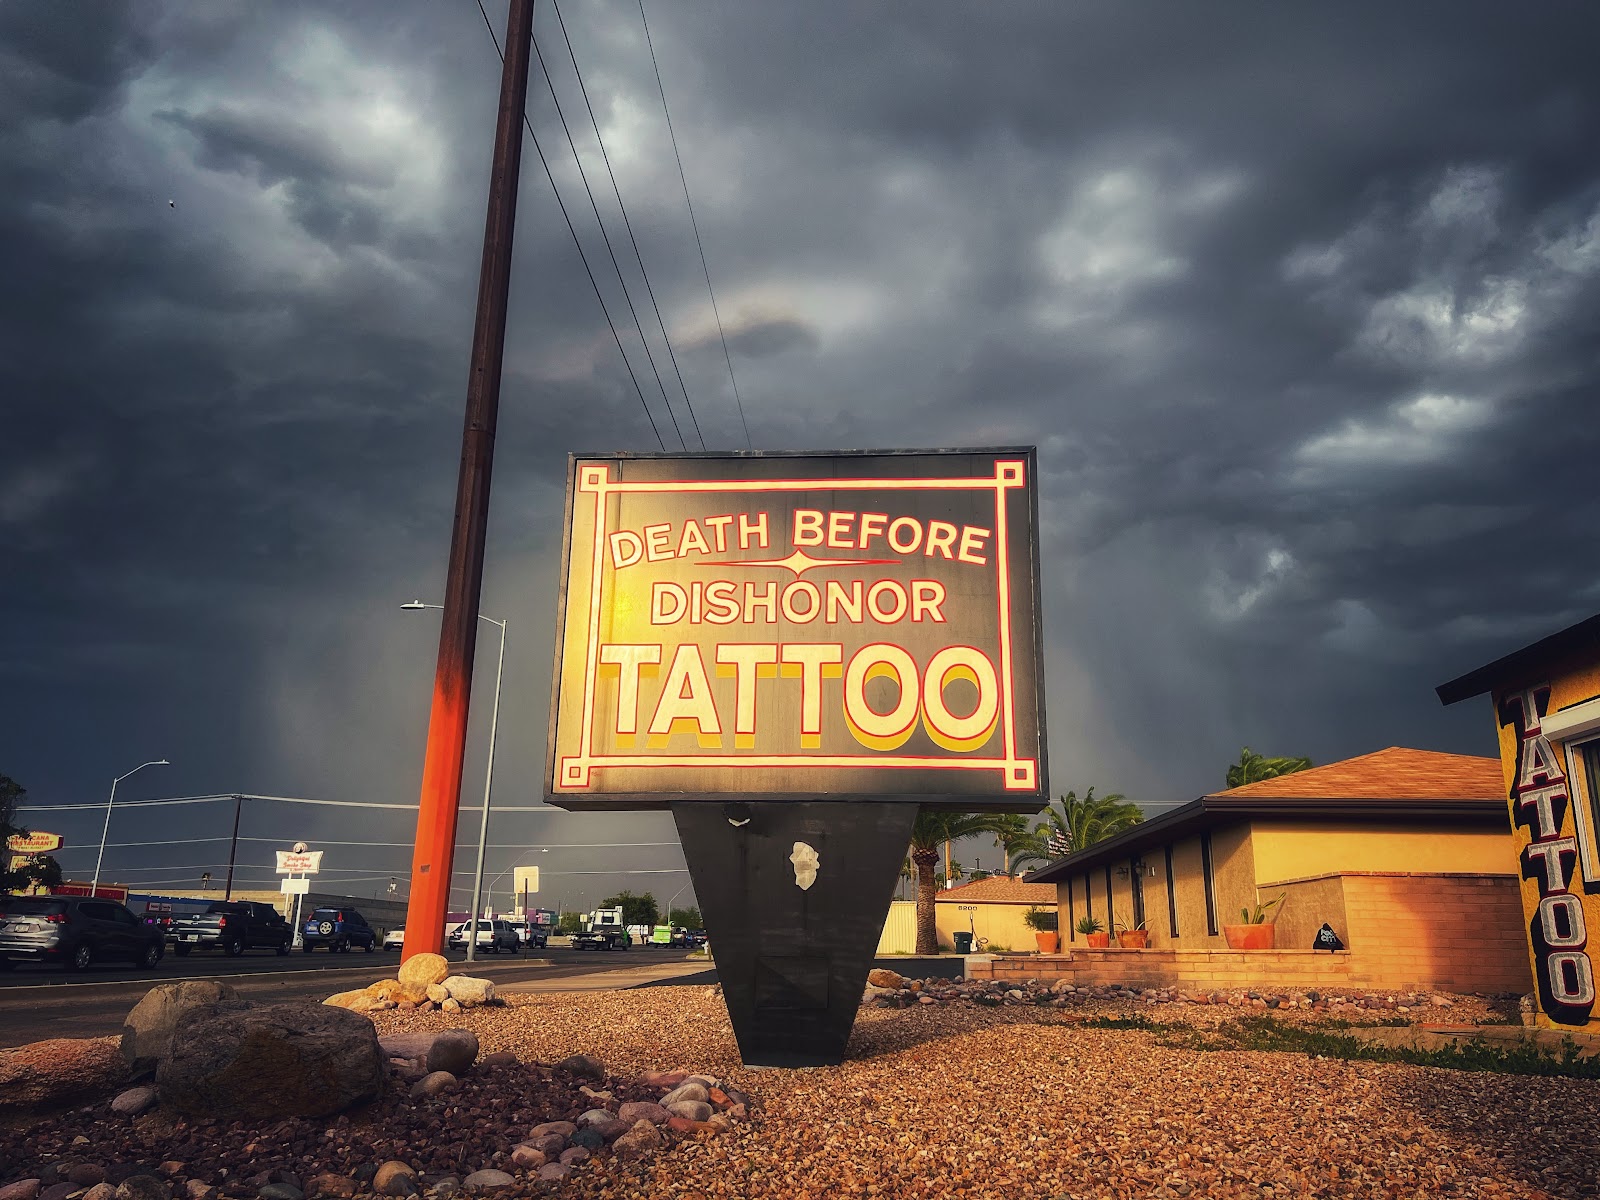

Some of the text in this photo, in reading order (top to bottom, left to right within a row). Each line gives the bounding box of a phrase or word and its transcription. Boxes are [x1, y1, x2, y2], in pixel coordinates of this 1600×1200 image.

[609, 508, 993, 570] DEATH BEFORE
[651, 580, 947, 625] DISHONOR
[600, 642, 1001, 740] TATTOO
[1506, 682, 1596, 1007] TATTOO
